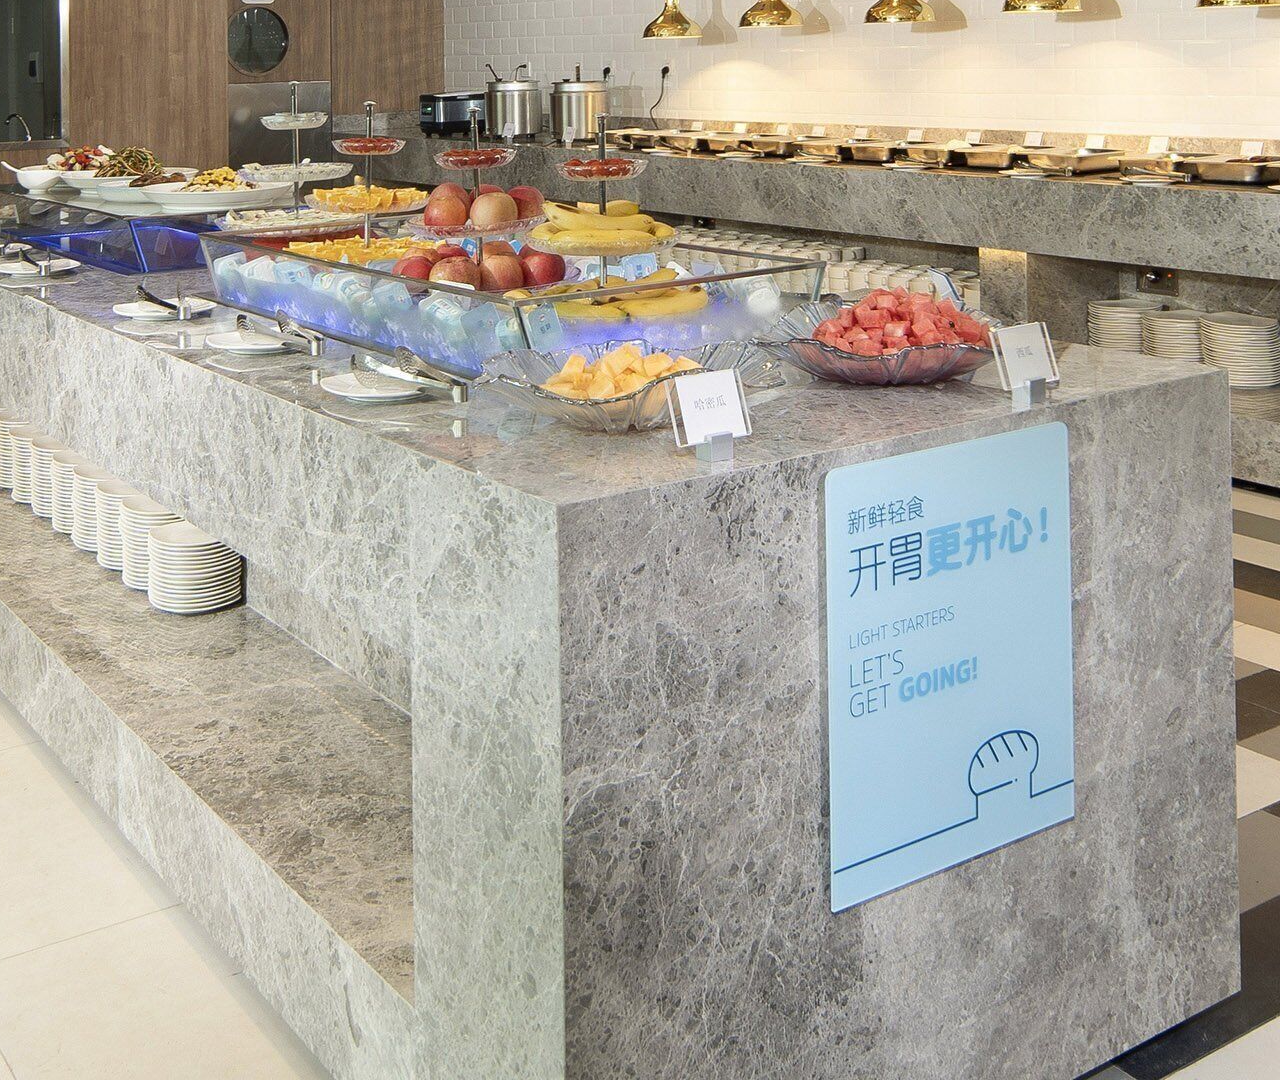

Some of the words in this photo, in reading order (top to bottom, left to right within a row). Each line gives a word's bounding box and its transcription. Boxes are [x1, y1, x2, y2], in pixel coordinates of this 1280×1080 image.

[848, 495, 925, 535] 新鲜轻食
[848, 506, 1048, 598] 开胃更开心!
[849, 624, 888, 650] LIGHT
[892, 605, 955, 638] STARTERS
[849, 649, 904, 689] LET'S
[849, 682, 891, 718] GET
[898, 655, 978, 703] GOING!
